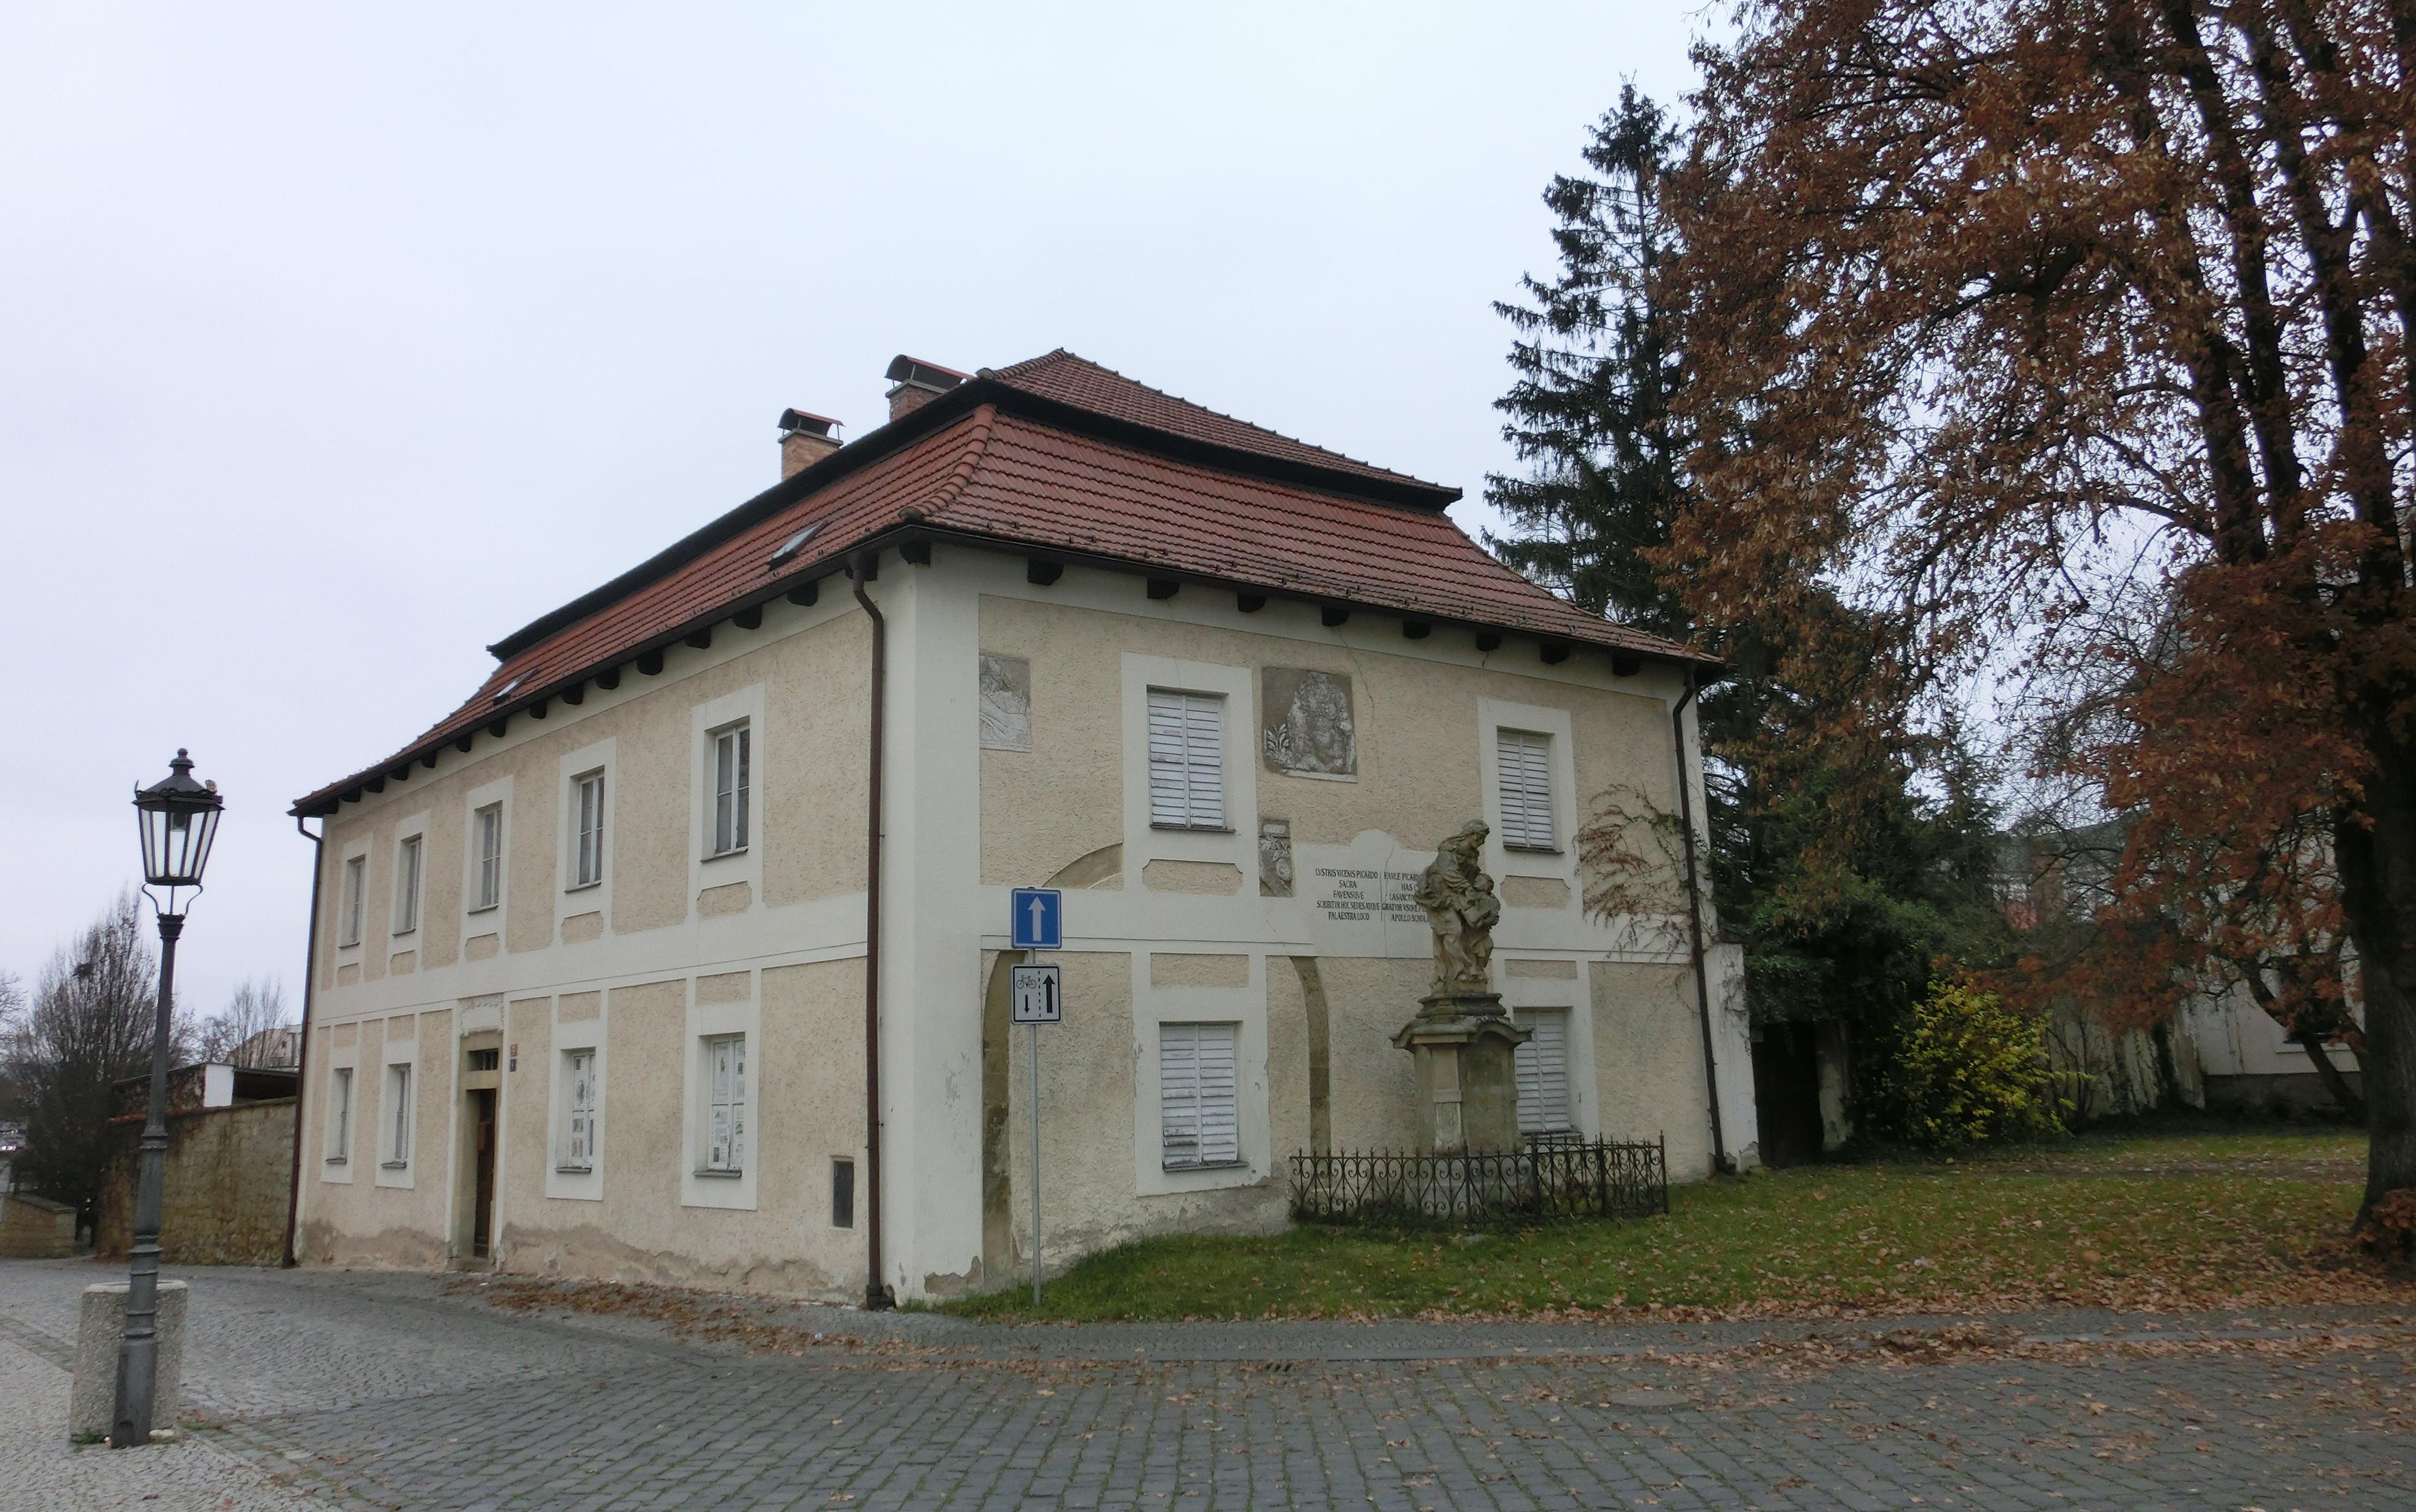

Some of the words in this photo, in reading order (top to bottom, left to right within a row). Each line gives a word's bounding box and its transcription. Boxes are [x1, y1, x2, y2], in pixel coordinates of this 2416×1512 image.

[1357, 871, 1378, 879] PICARDO
[1339, 880, 1357, 888] SACRA
[1357, 912, 1370, 921] LOCO
